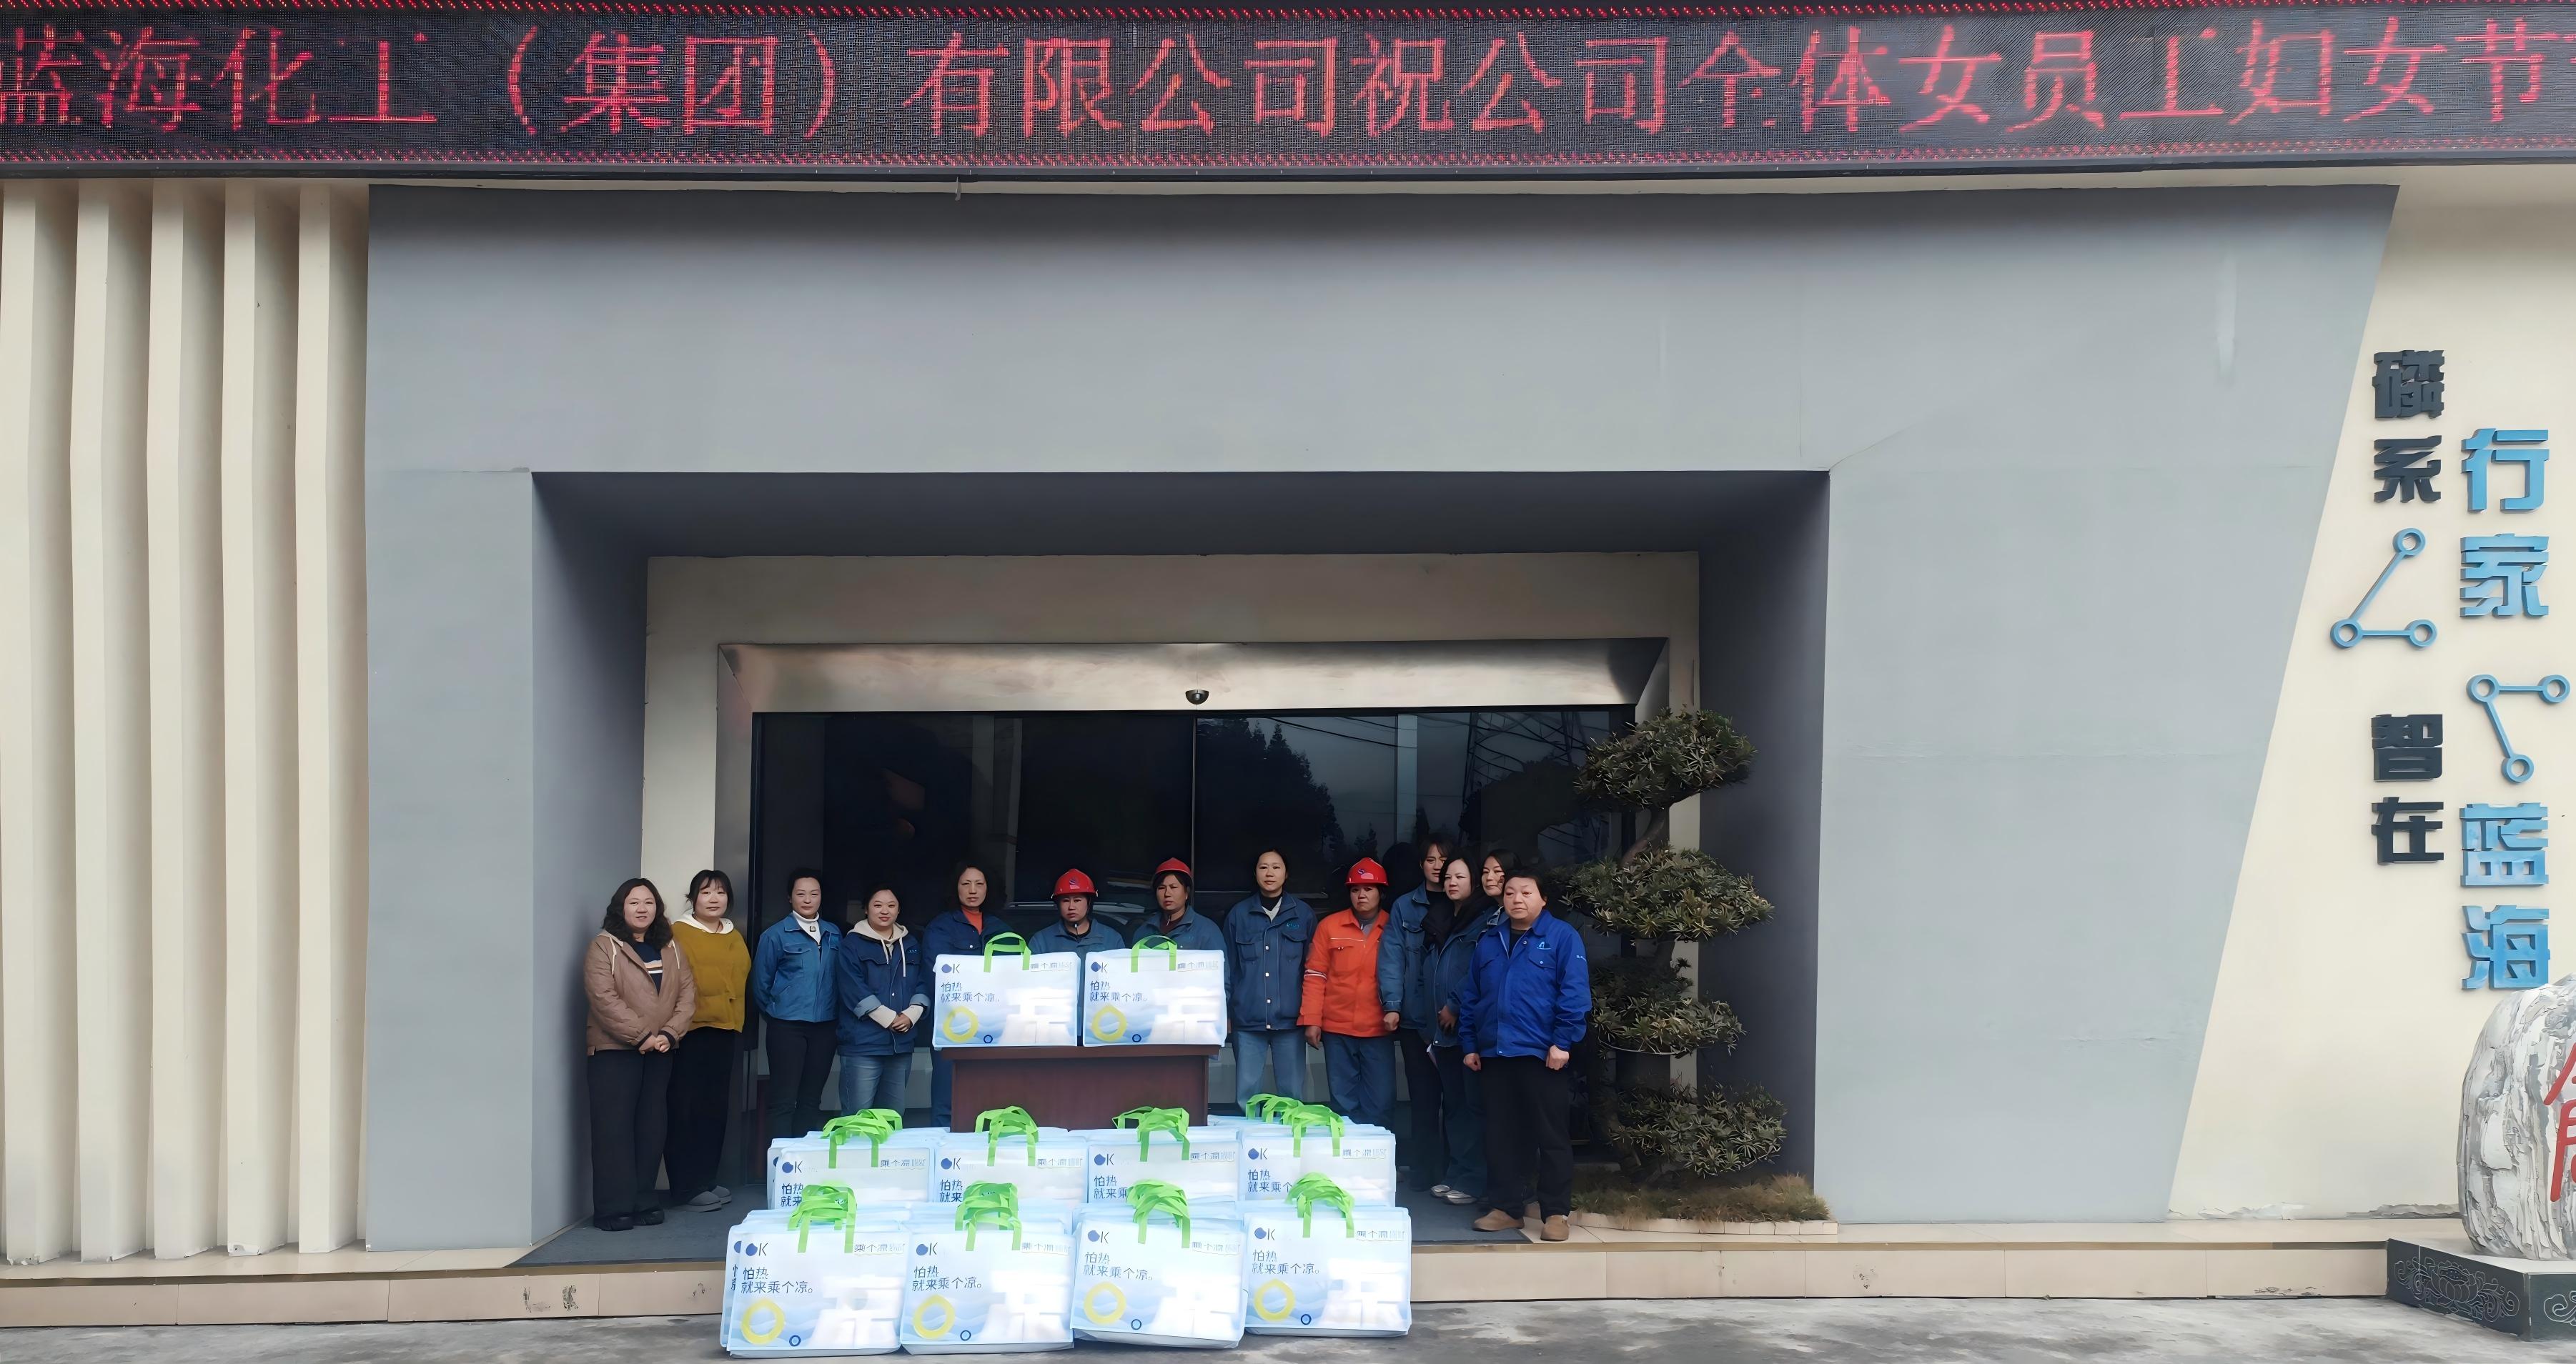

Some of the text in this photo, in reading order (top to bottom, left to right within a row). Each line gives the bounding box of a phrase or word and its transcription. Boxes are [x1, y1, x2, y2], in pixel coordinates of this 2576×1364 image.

[0, 17, 2575, 137] 蓝海化工（集团）有限公司祝公司全体女员工妇女节
[2459, 427, 2550, 990] 行家 蓝海
[2371, 714, 2444, 865] 智在
[740, 1280, 813, 1294] 就来乘个凉。
[743, 1267, 769, 1280] 怕热
[913, 1265, 939, 1279] 怕热
